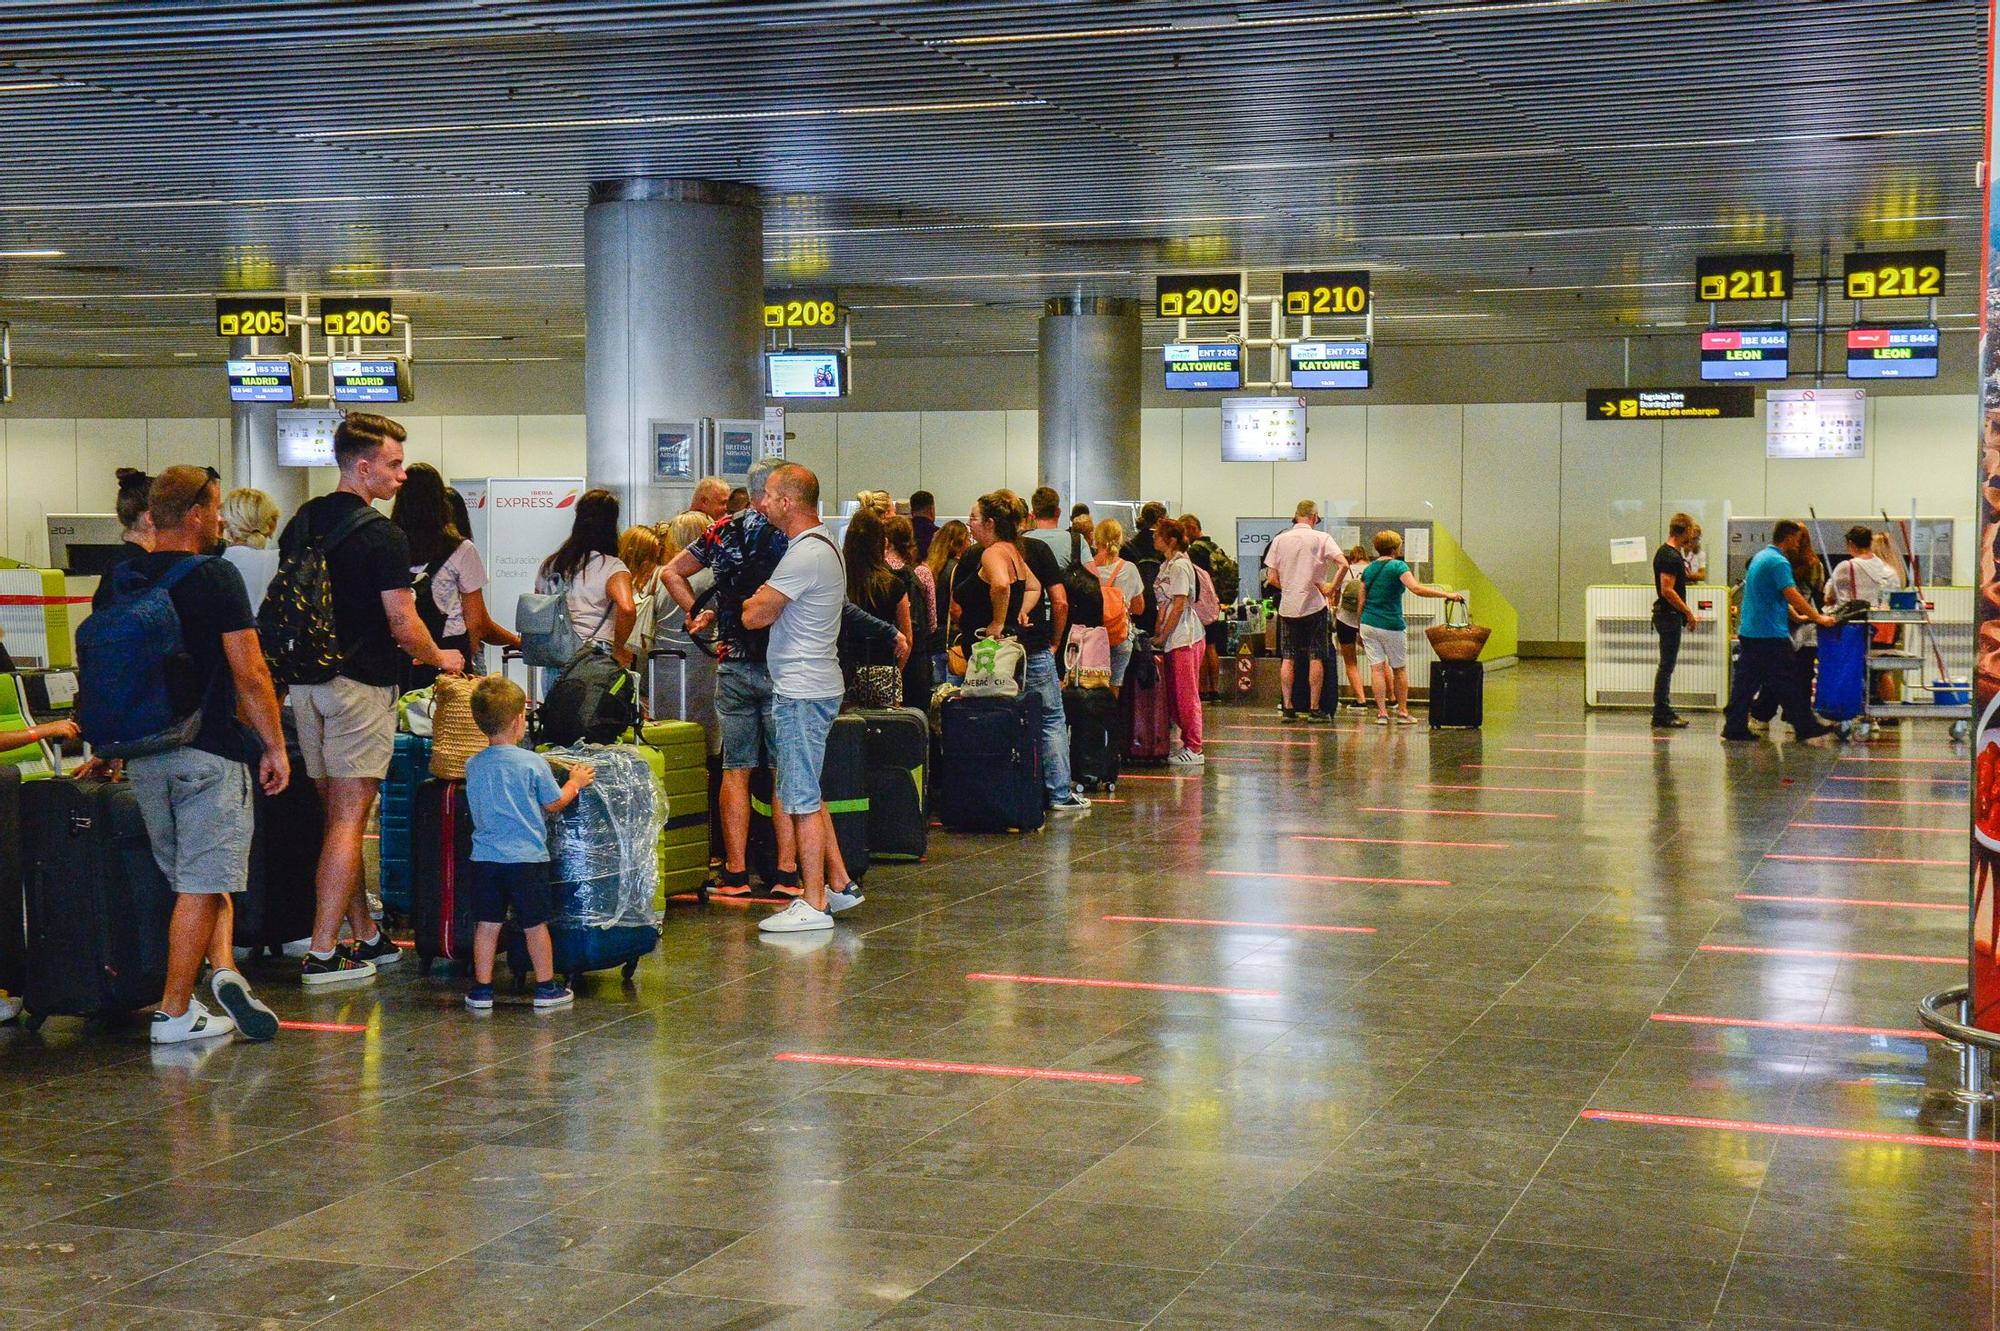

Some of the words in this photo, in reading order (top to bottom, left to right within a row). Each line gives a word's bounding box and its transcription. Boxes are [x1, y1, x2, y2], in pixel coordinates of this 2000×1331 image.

[1729, 270, 1786, 298] 211
[1878, 266, 1940, 296] 212
[1185, 288, 1239, 315] 209
[1313, 286, 1366, 313] 210
[787, 301, 836, 326] 208
[241, 310, 285, 334] 205
[346, 310, 391, 334] 206
[1199, 349, 1216, 357] ENT
[1327, 348, 1343, 356] ENT
[1726, 349, 1762, 360] LEON
[1873, 348, 1912, 359] LEON
[1172, 362, 1232, 371] KATOWICE
[1298, 361, 1360, 370] KATOWICE
[241, 377, 279, 385] MADRID
[346, 377, 384, 386] MADRID
[1640, 408, 1669, 416] Puertas
[1681, 408, 1720, 416] embarque
[496, 497, 554, 508] EXPRESS
[51, 527, 75, 535] 203
[1240, 534, 1271, 544] 209
